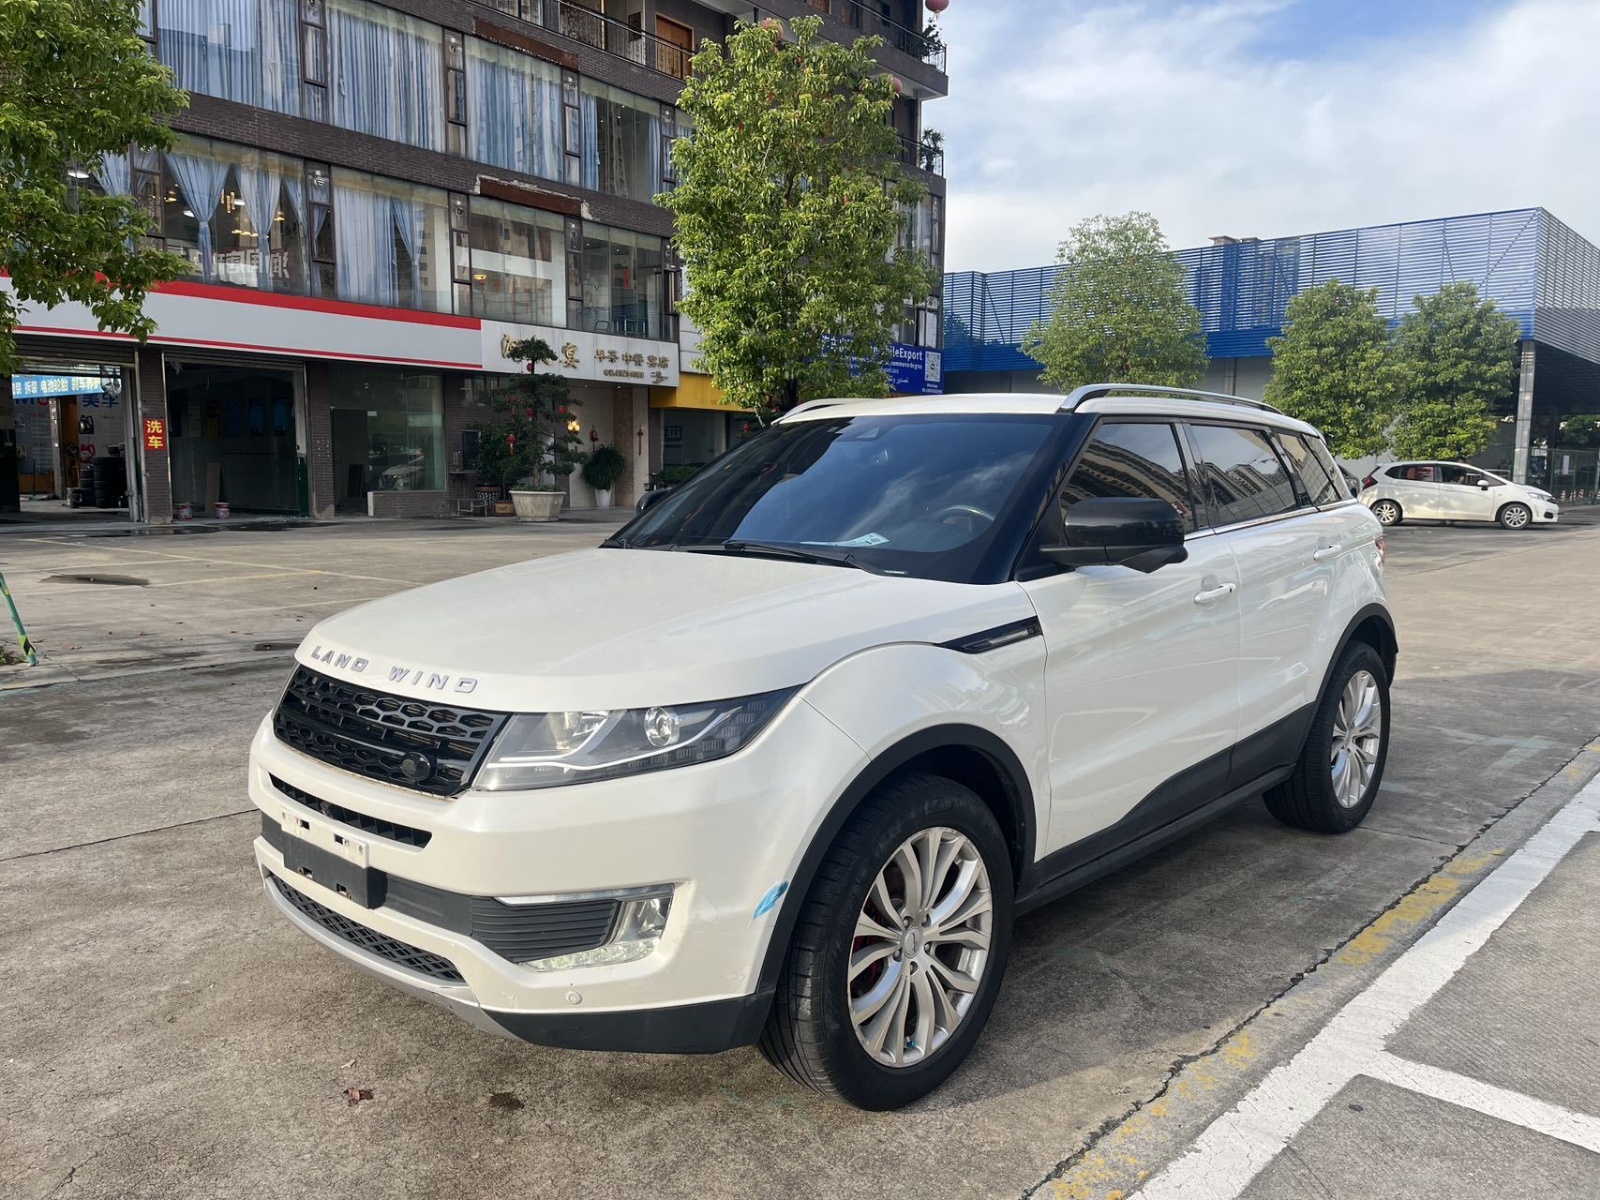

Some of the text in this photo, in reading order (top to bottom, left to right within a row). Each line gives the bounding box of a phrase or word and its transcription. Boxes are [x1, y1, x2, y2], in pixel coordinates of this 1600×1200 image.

[146, 420, 163, 449] 洗车
[311, 646, 478, 694] LAND WIND
